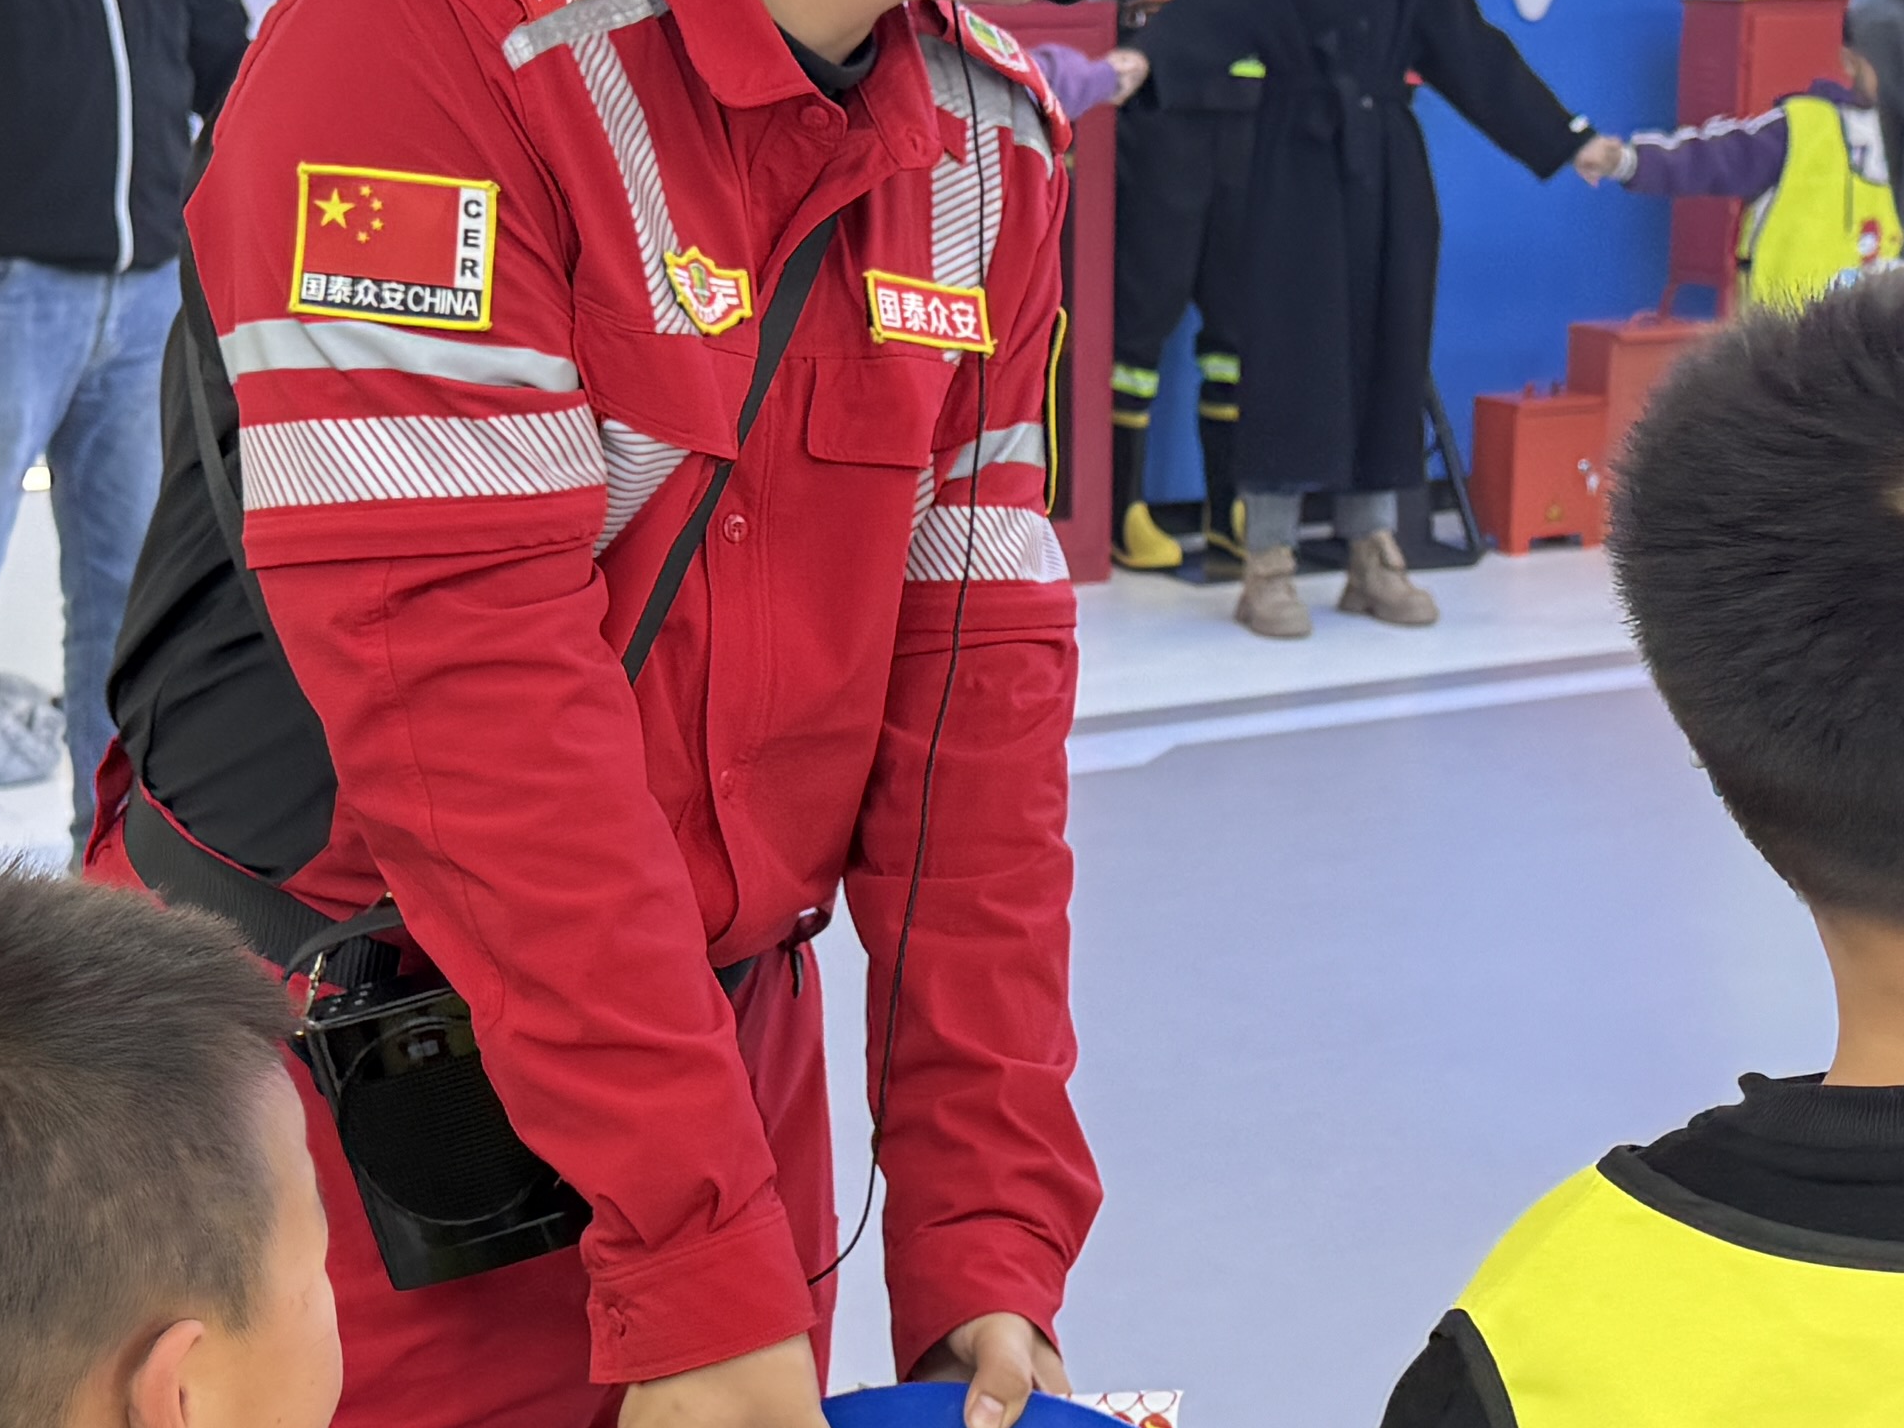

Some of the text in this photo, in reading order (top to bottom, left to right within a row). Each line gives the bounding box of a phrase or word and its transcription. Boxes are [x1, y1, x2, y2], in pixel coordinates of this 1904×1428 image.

[460, 200, 483, 279] CER
[877, 287, 981, 341] 国泰众安
